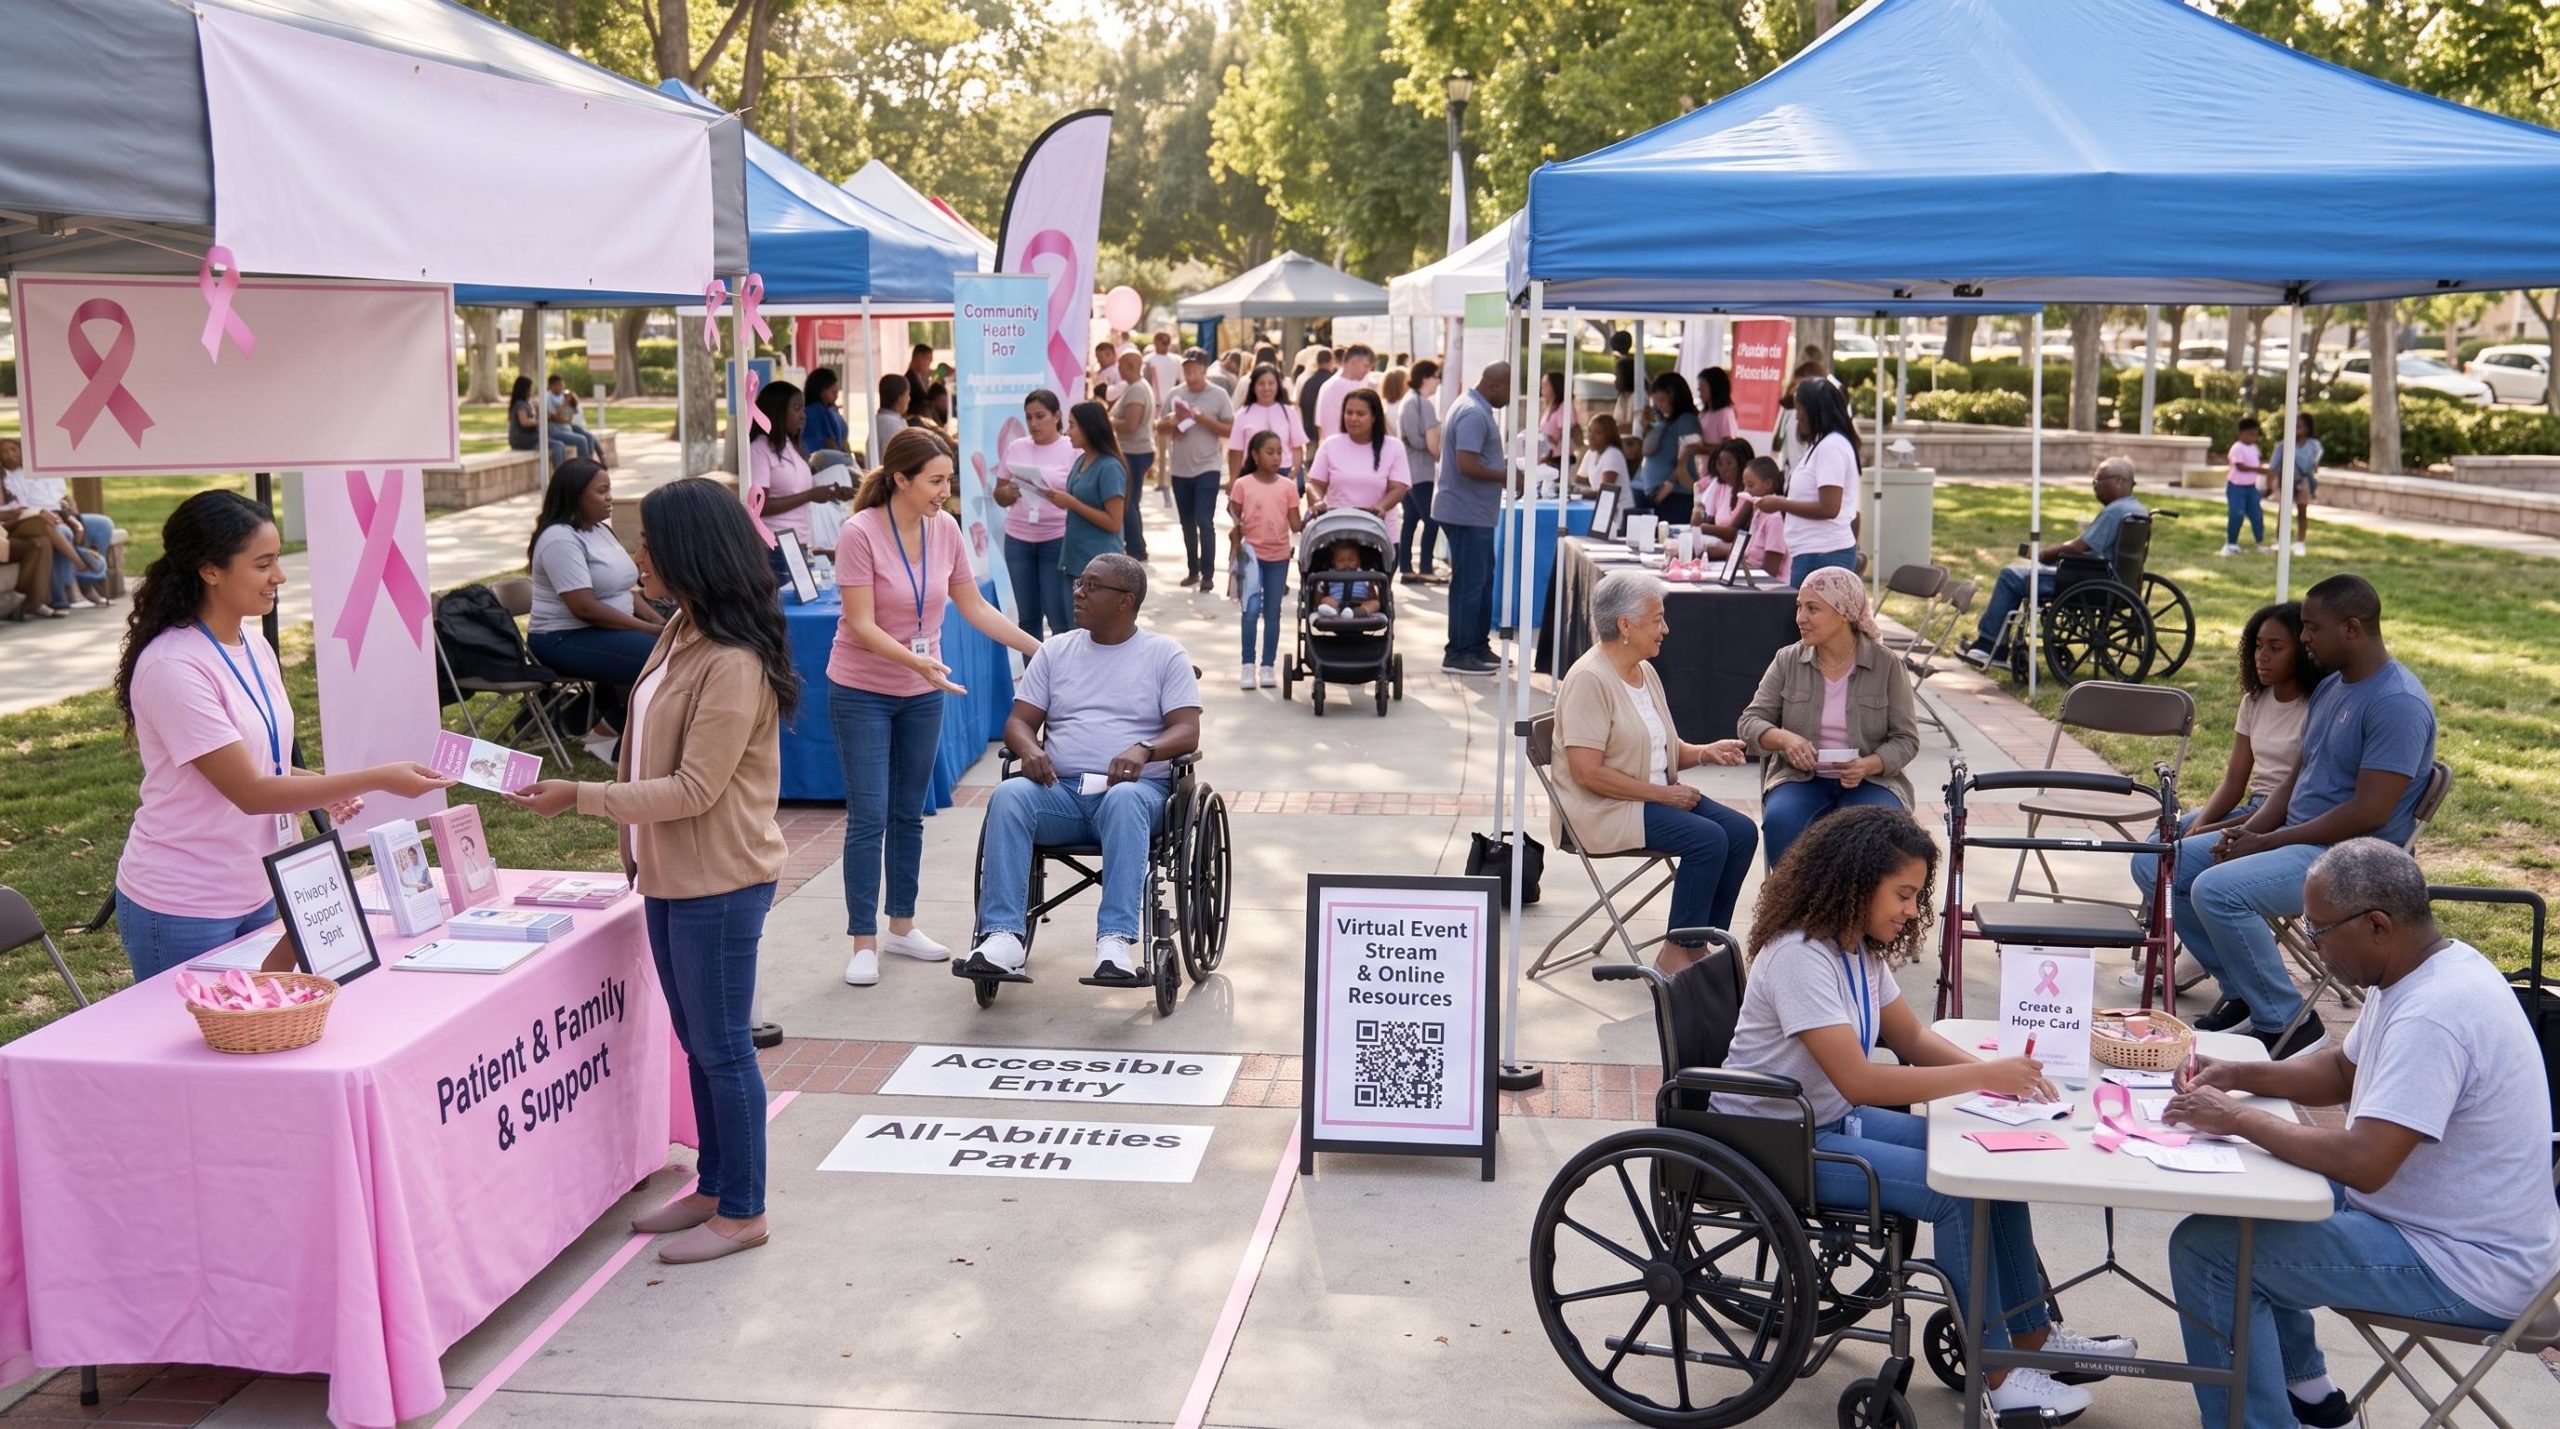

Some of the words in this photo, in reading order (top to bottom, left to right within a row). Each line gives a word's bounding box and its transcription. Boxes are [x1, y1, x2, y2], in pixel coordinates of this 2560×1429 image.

[964, 303, 1040, 321] Community
[293, 882, 329, 905] Privacy
[329, 876, 339, 892] &
[303, 900, 344, 927] Support
[1337, 918, 1405, 937] Virtual
[1411, 920, 1468, 939] Event
[1365, 942, 1437, 961] Stream
[1357, 964, 1372, 982] &
[1378, 965, 1445, 984] Online
[1348, 986, 1453, 1007] Resources
[2018, 1000, 2061, 1014] Create
[2065, 1006, 2073, 1015] a
[2011, 1015, 2046, 1030] Hope
[2049, 1017, 2080, 1031] Card
[436, 1035, 527, 1126] Patient
[532, 1018, 550, 1064] &
[554, 976, 626, 1050] Family
[931, 1053, 1204, 1076] Accessible
[497, 1104, 516, 1152] &
[520, 1042, 611, 1133] Support
[988, 1075, 1126, 1098] Entry
[865, 1121, 1182, 1149] All-Abilities
[948, 1149, 1072, 1171] Path
